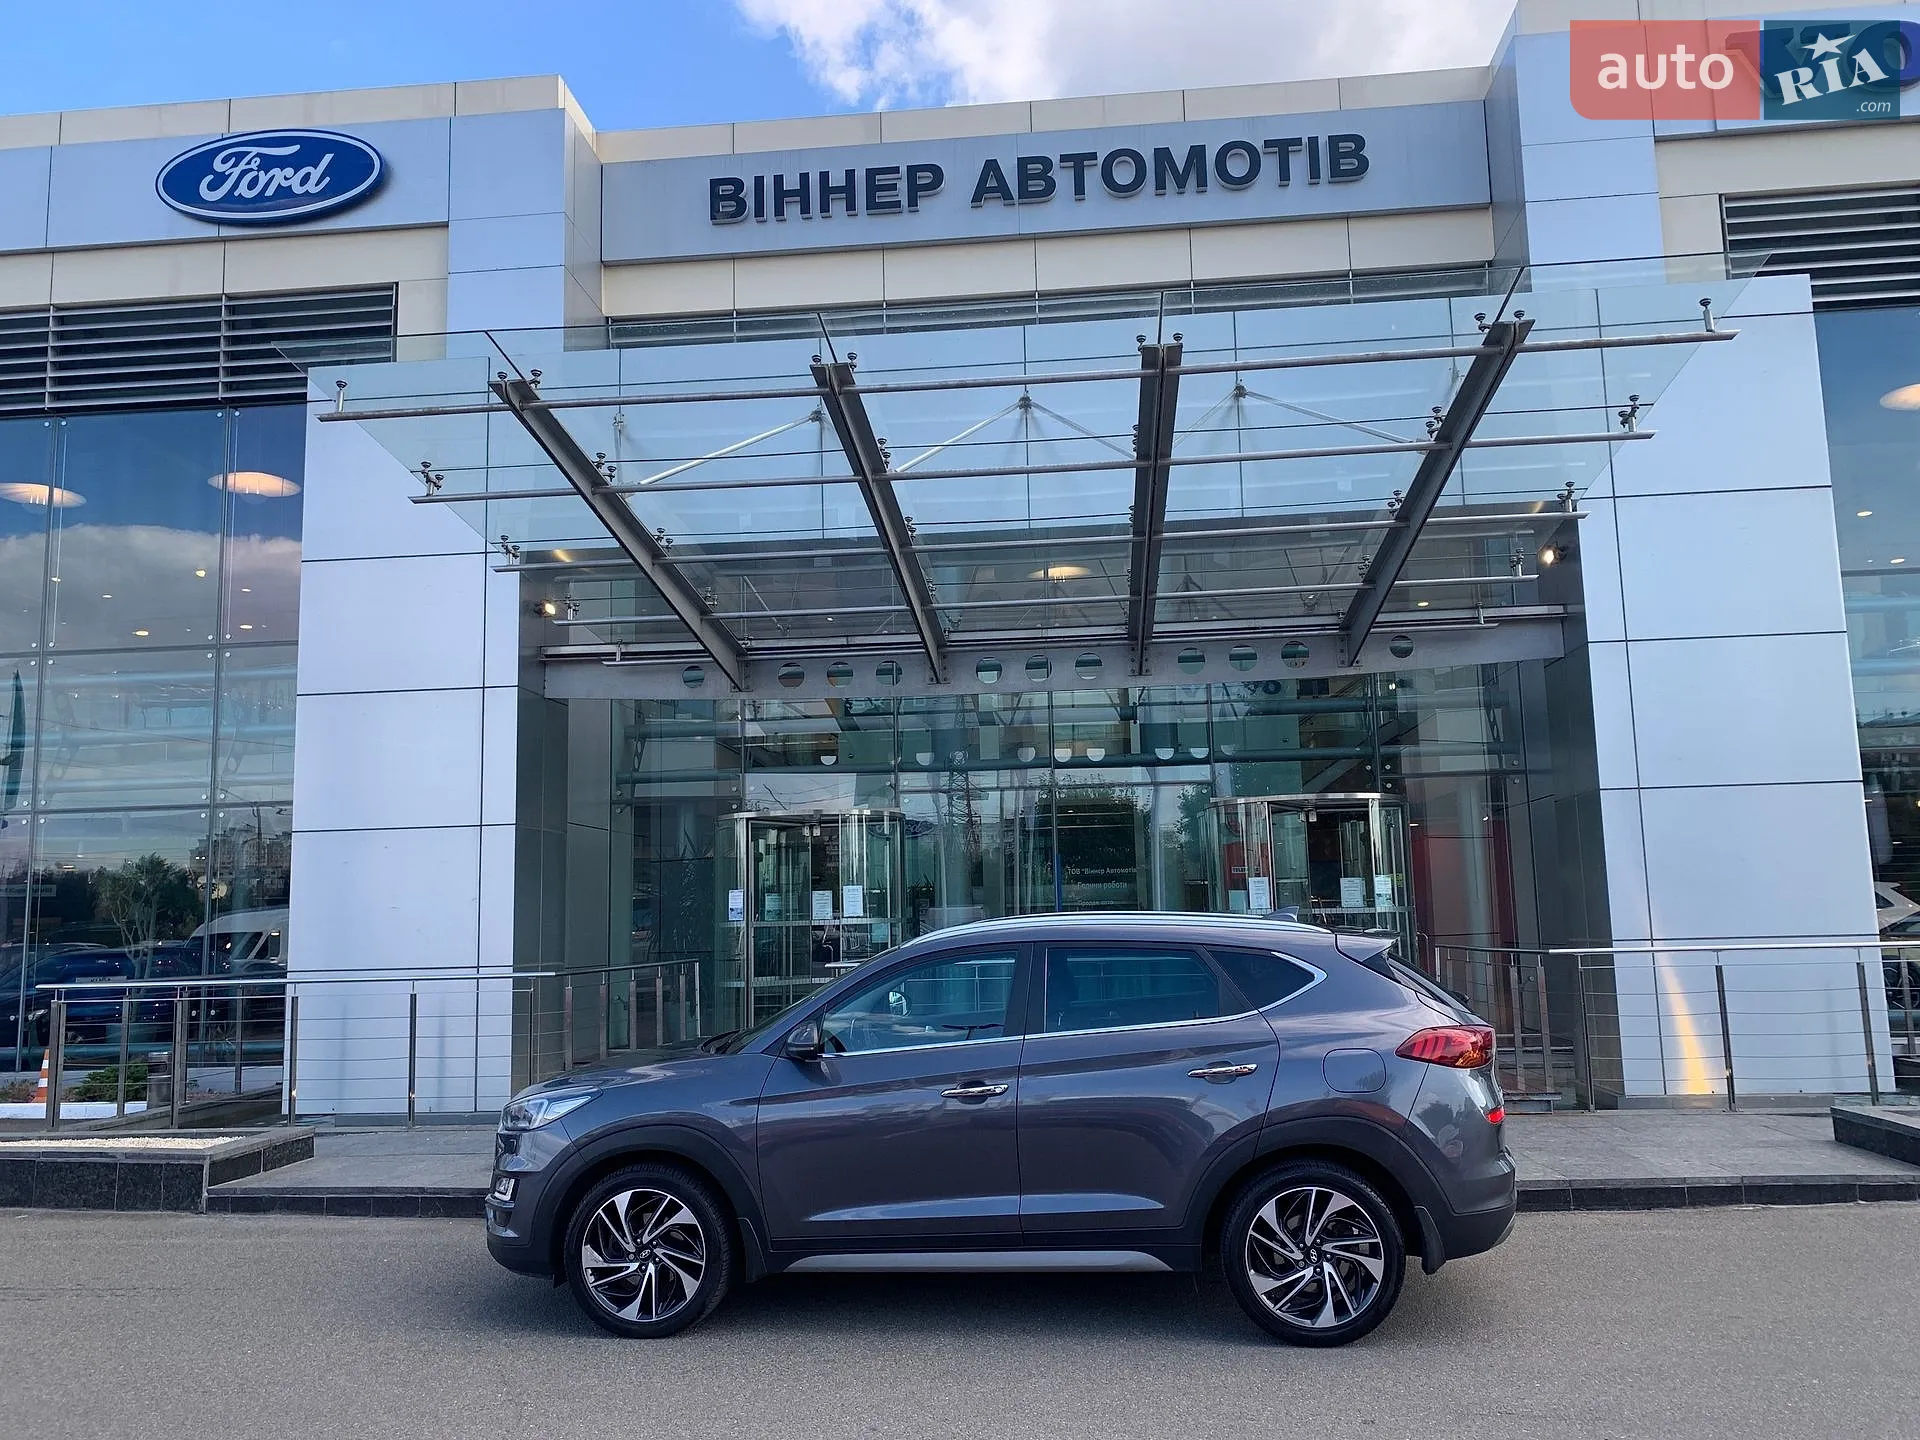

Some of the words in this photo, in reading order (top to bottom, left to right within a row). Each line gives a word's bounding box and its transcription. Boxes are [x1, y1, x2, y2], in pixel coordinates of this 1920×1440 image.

[199, 144, 335, 202] Ford
[709, 162, 946, 225] ВІННЕР
[970, 133, 1371, 208] АВТОМОТІВ
